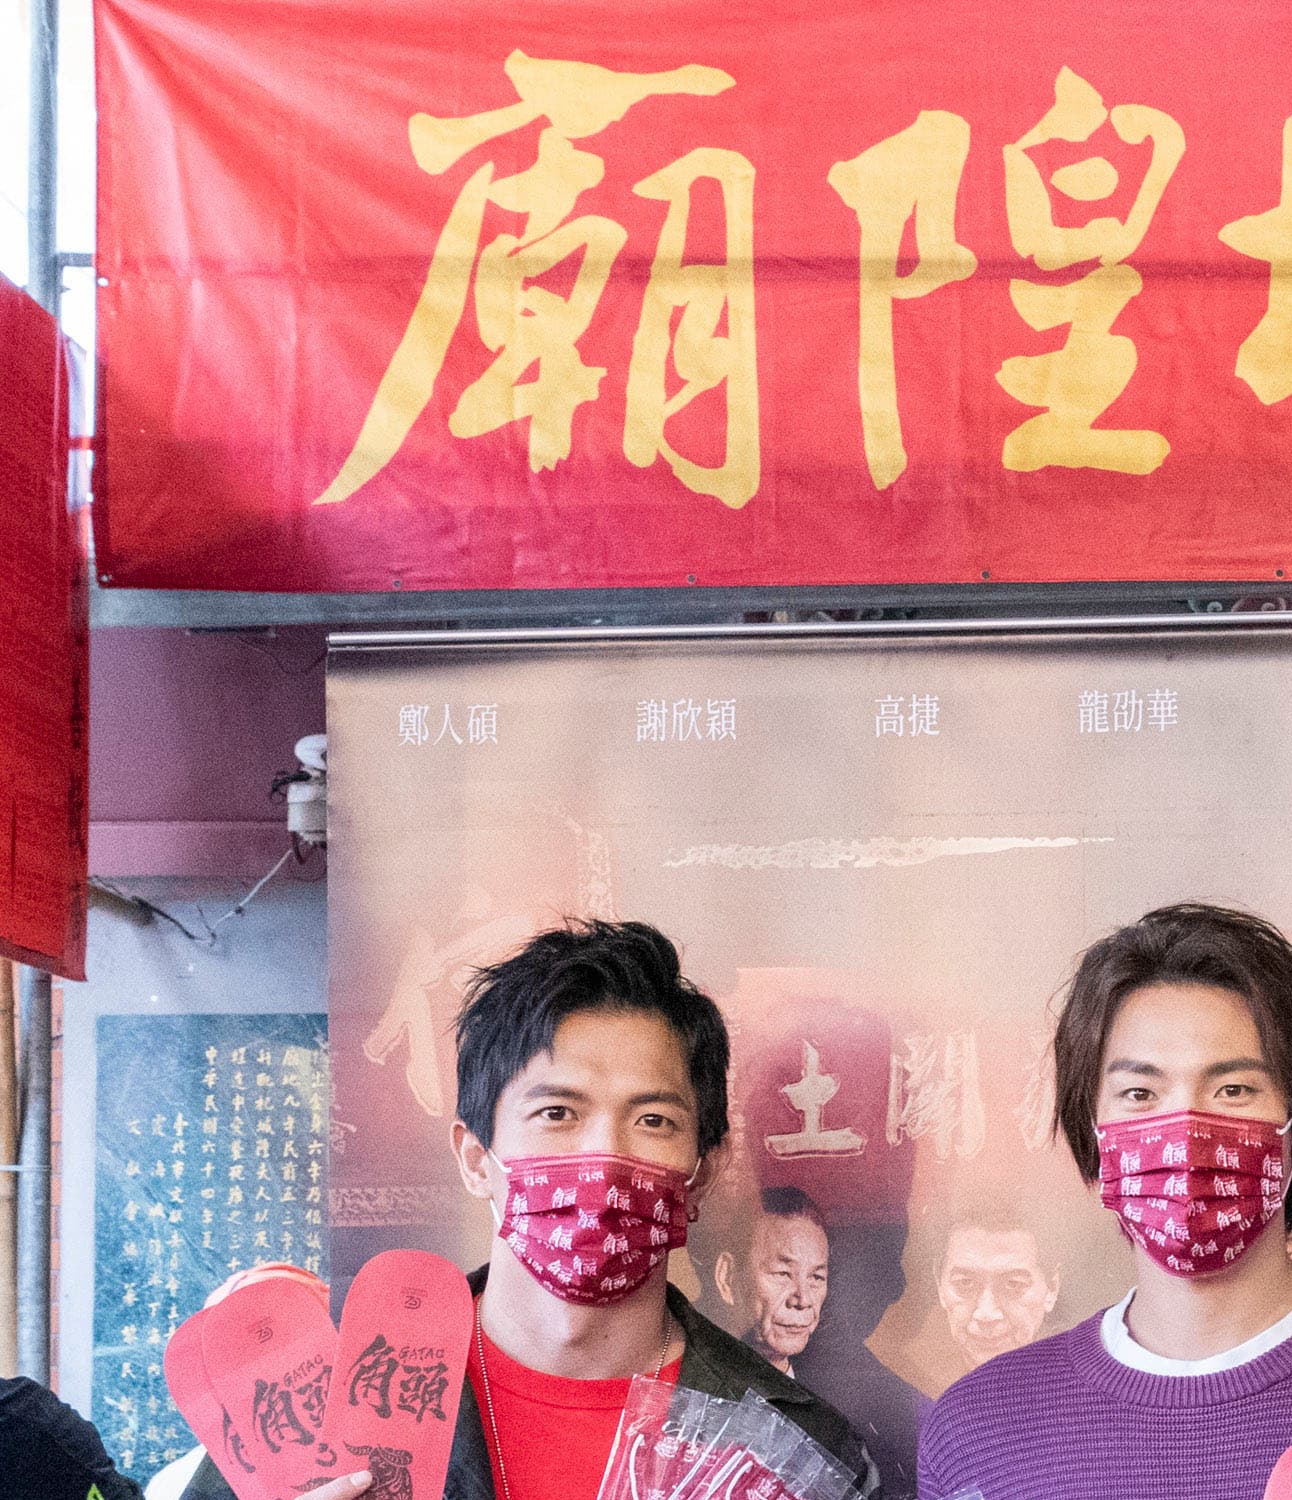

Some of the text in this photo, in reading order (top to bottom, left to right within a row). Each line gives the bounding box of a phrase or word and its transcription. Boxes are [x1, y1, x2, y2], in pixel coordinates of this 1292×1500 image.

[398, 703, 499, 747] 鄭人碩
[635, 697, 738, 742] 謝欣穎
[873, 695, 941, 738] 高捷
[1077, 688, 1180, 735] 龍劭華
[1162, 1142, 1188, 1165] 角頭
[1216, 1144, 1240, 1169] 角頭
[606, 1185, 631, 1210] 角頭
[603, 1232, 629, 1254] 角頭
[398, 1346, 446, 1360] GATAO
[343, 1333, 449, 1424] 角頭
